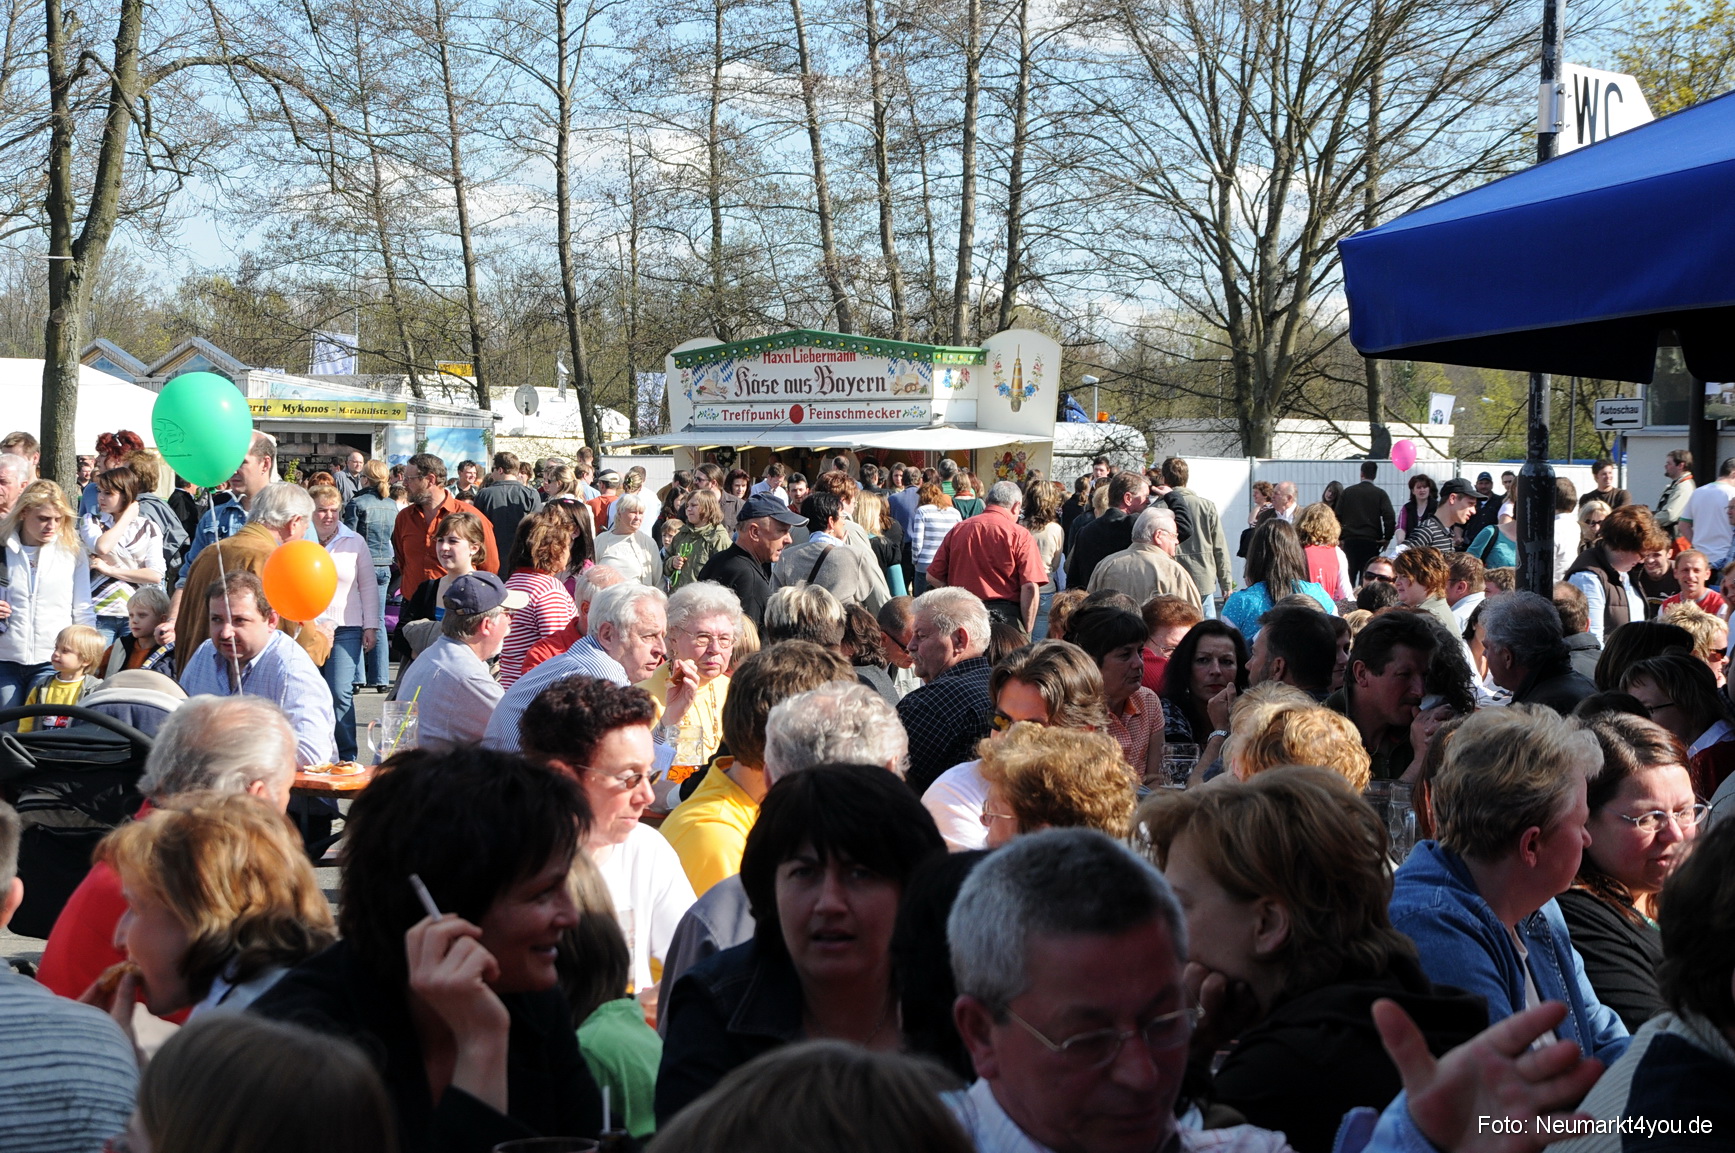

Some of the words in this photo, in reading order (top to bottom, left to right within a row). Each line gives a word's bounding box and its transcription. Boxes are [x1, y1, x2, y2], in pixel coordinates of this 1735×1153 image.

[1573, 73, 1624, 145] WC
[792, 347, 857, 364] Liebermann
[734, 364, 780, 398] Käse
[784, 375, 813, 395] aus
[813, 364, 888, 397] Bayern
[281, 403, 329, 415] Mykonos
[391, 408, 402, 416] 29
[721, 408, 785, 422] Treffpunkt
[808, 407, 902, 420] Feinschmecker
[1600, 405, 1639, 415] Autoschau
